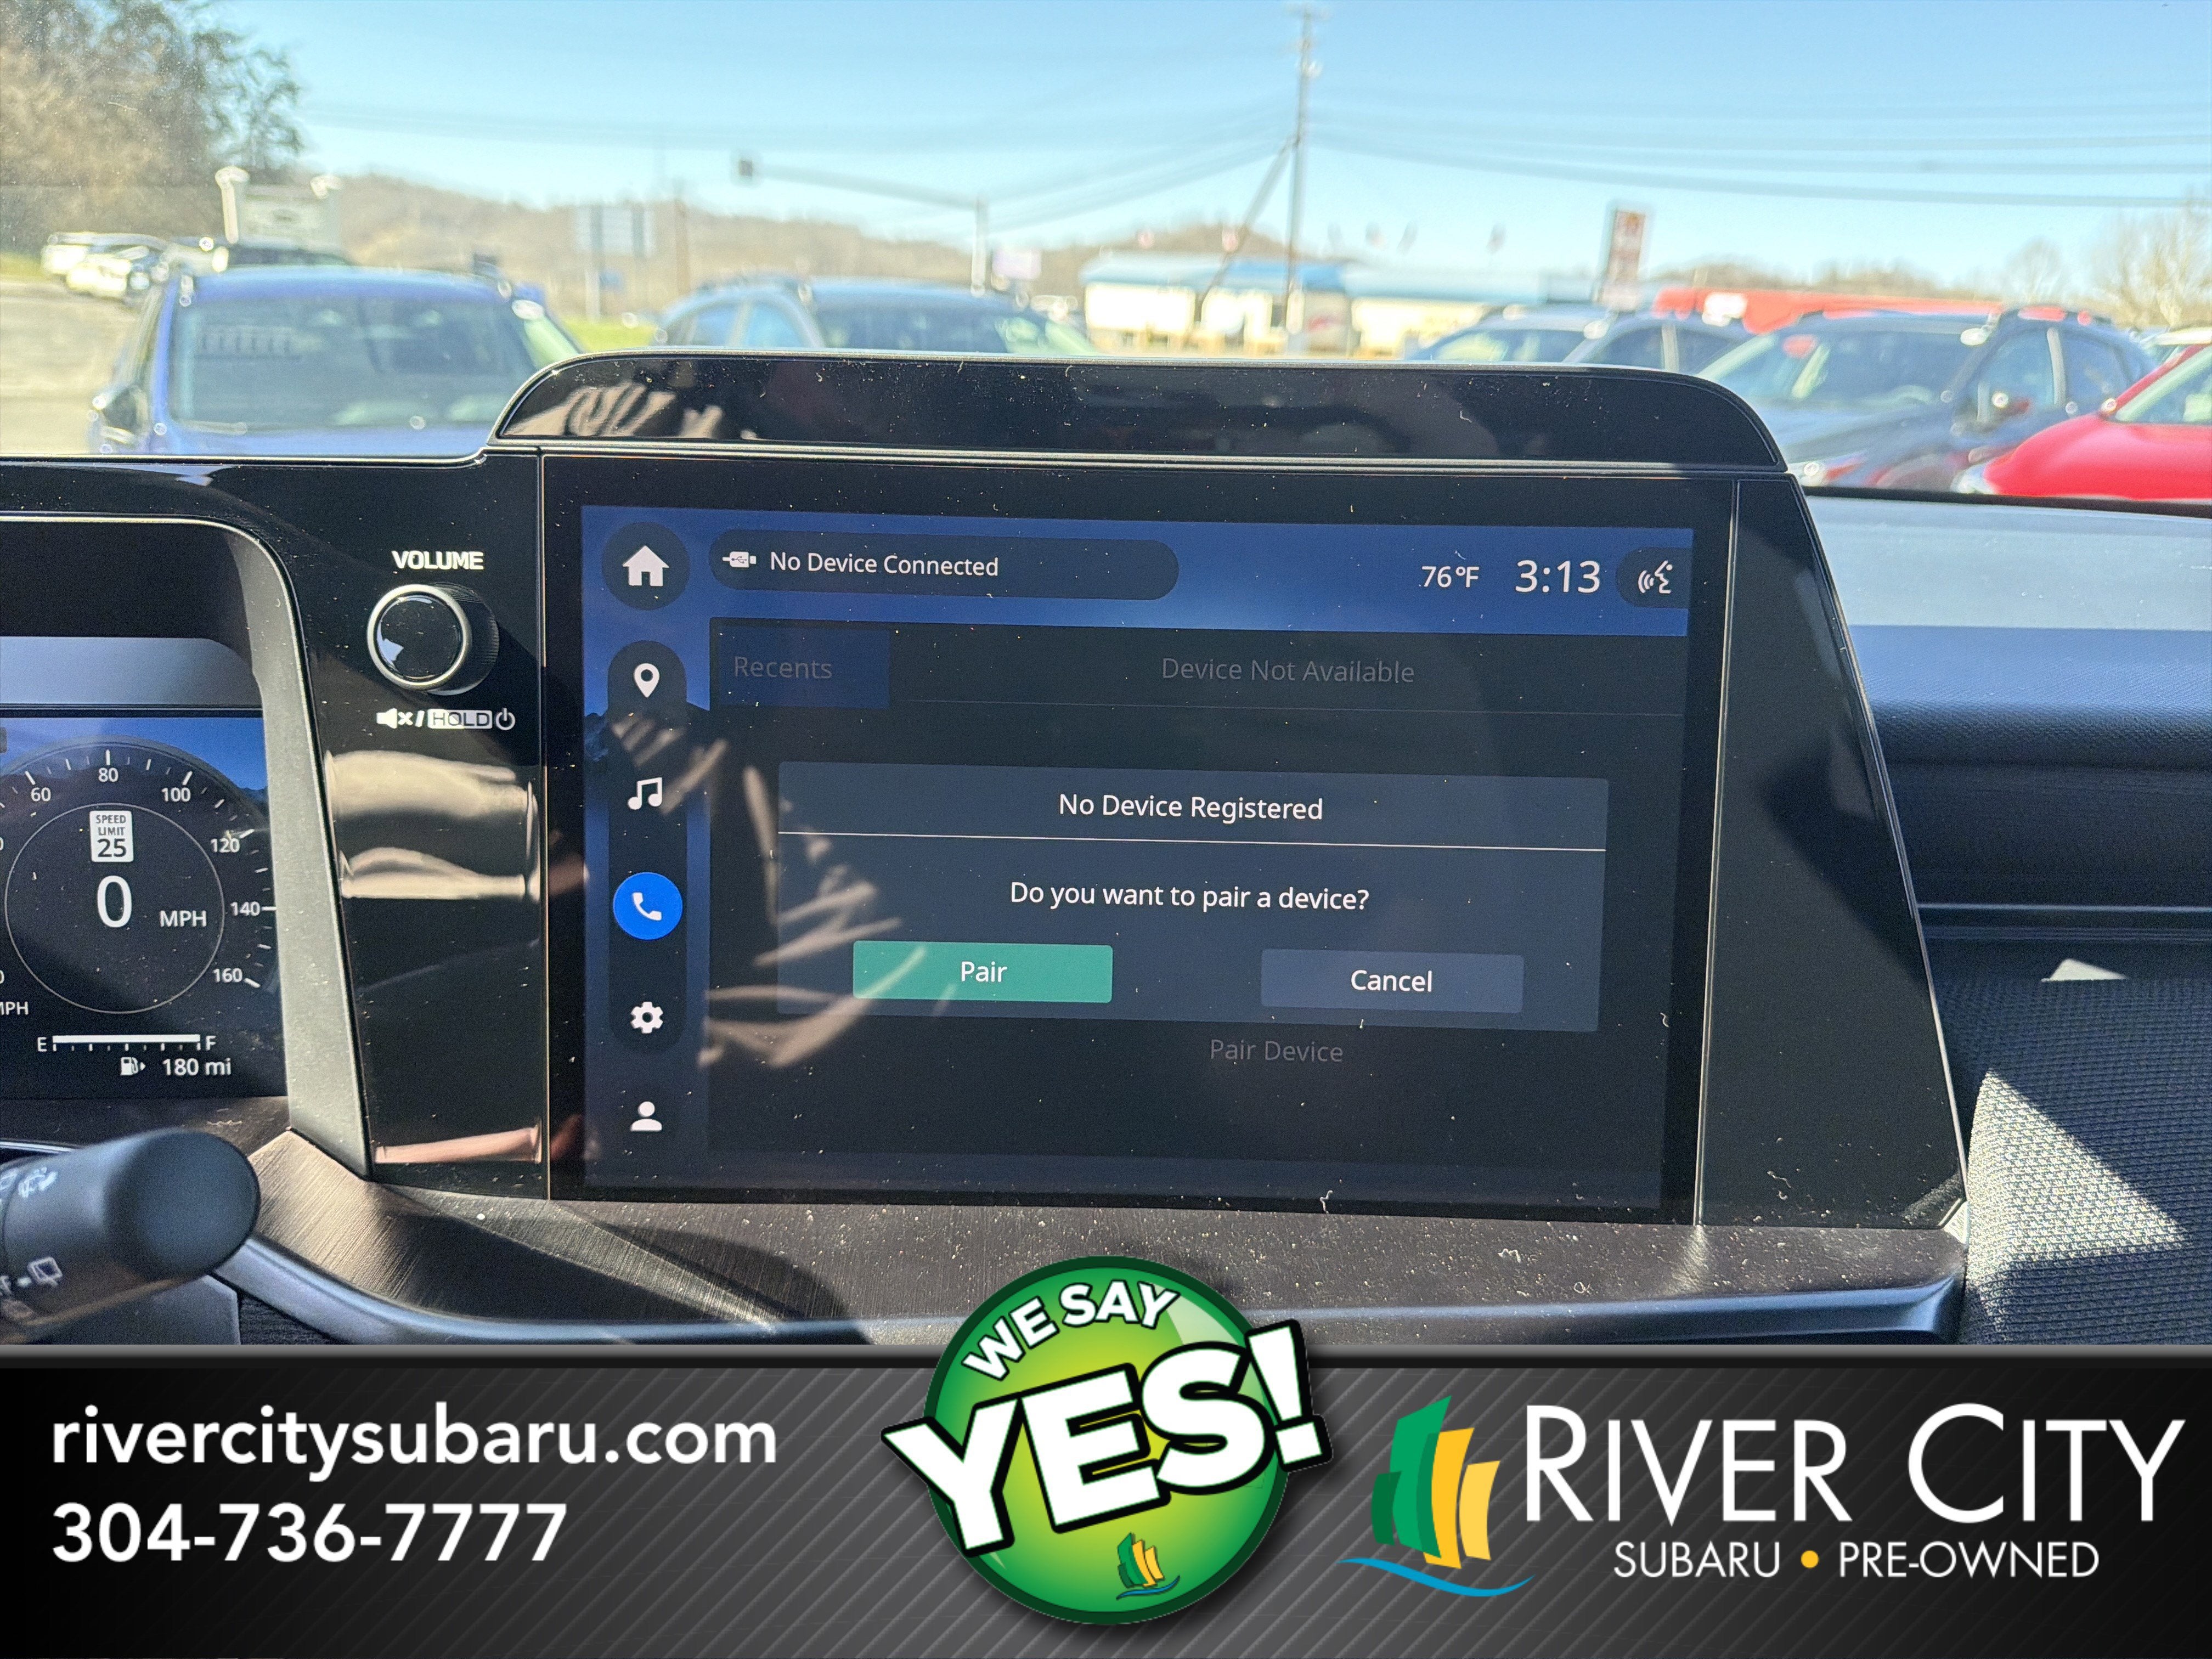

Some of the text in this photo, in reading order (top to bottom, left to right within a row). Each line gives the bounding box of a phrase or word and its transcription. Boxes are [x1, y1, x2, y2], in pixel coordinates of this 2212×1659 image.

[392, 550, 483, 569] VOLUME
[771, 552, 998, 575] No Device Connected
[1516, 560, 1600, 592] 3:13
[735, 657, 832, 680] Recents
[1163, 658, 1414, 683] Device Not Available
[99, 768, 118, 782] 80
[31, 787, 50, 802] 60
[162, 787, 190, 802] 100
[1060, 794, 1322, 823] No Device Registered
[95, 815, 126, 823] SPEED
[98, 827, 126, 836] LIMIT
[97, 838, 127, 857] 25
[211, 839, 240, 853] 120
[98, 876, 206, 927] 0 MPH
[1012, 882, 1369, 912] Do you want to pair a device?
[231, 901, 260, 916] 140
[213, 968, 242, 982] 160
[962, 962, 1007, 982] Pair
[1351, 970, 1432, 992] Cancel
[38, 1037, 47, 1051] E
[206, 1036, 216, 1048] F
[1211, 1040, 1342, 1062] Pair Device
[163, 1058, 230, 1075] 180 mi
